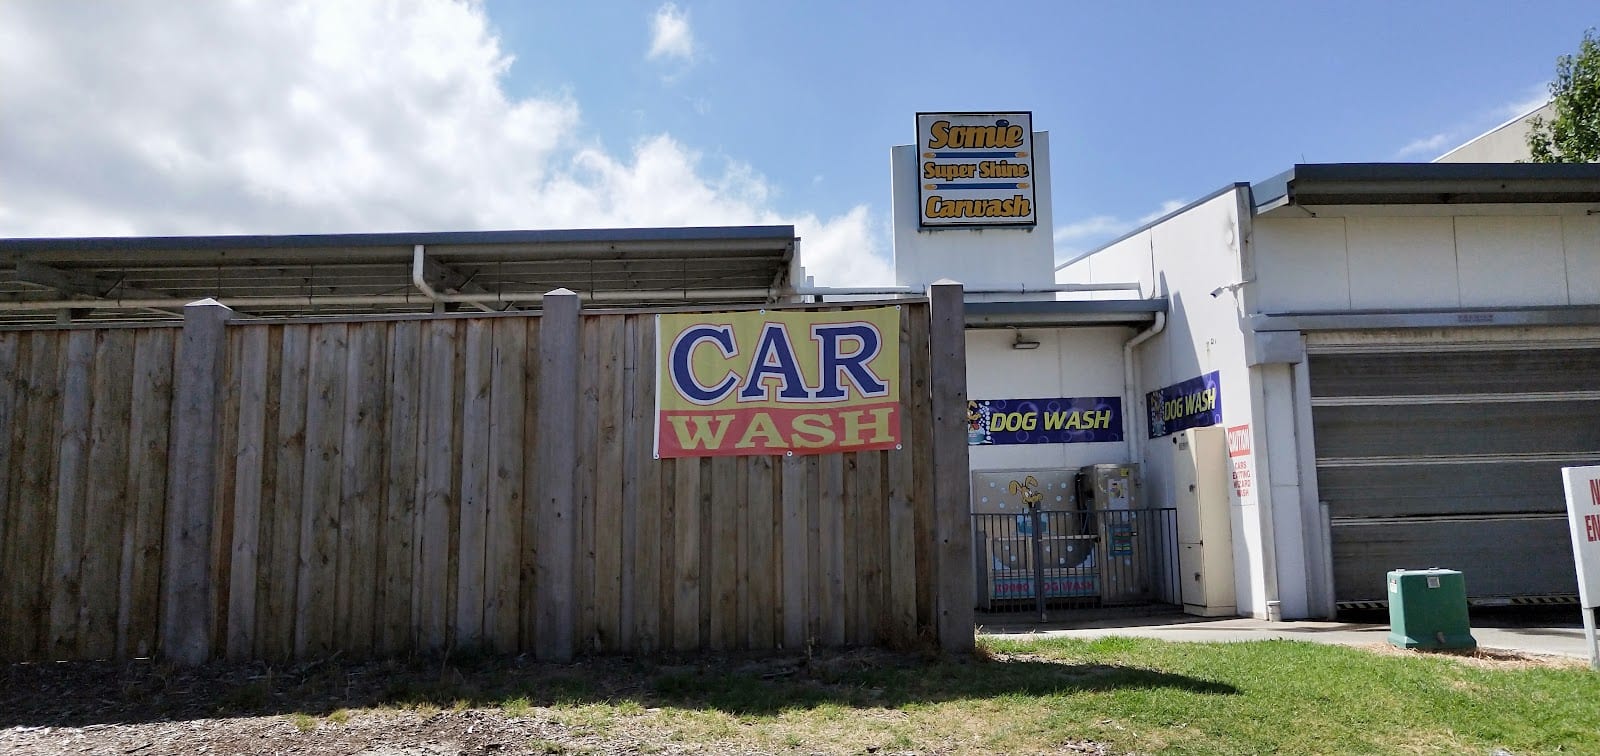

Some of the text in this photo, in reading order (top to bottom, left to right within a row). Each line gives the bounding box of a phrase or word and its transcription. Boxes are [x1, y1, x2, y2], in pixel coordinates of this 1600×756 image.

[928, 119, 1023, 149] Somie
[924, 160, 1029, 181] Super Shine
[925, 195, 1031, 218] Carwash
[668, 321, 889, 405] CAR
[1164, 388, 1216, 421] DOG WASH
[667, 407, 895, 450] WASH
[990, 410, 1110, 432] DOG WASH
[1228, 427, 1251, 453] CAUTION
[1234, 461, 1247, 469] CARS
[1589, 479, 1600, 505] N
[1584, 514, 1600, 542] EN
[1041, 582, 1059, 592] OG
